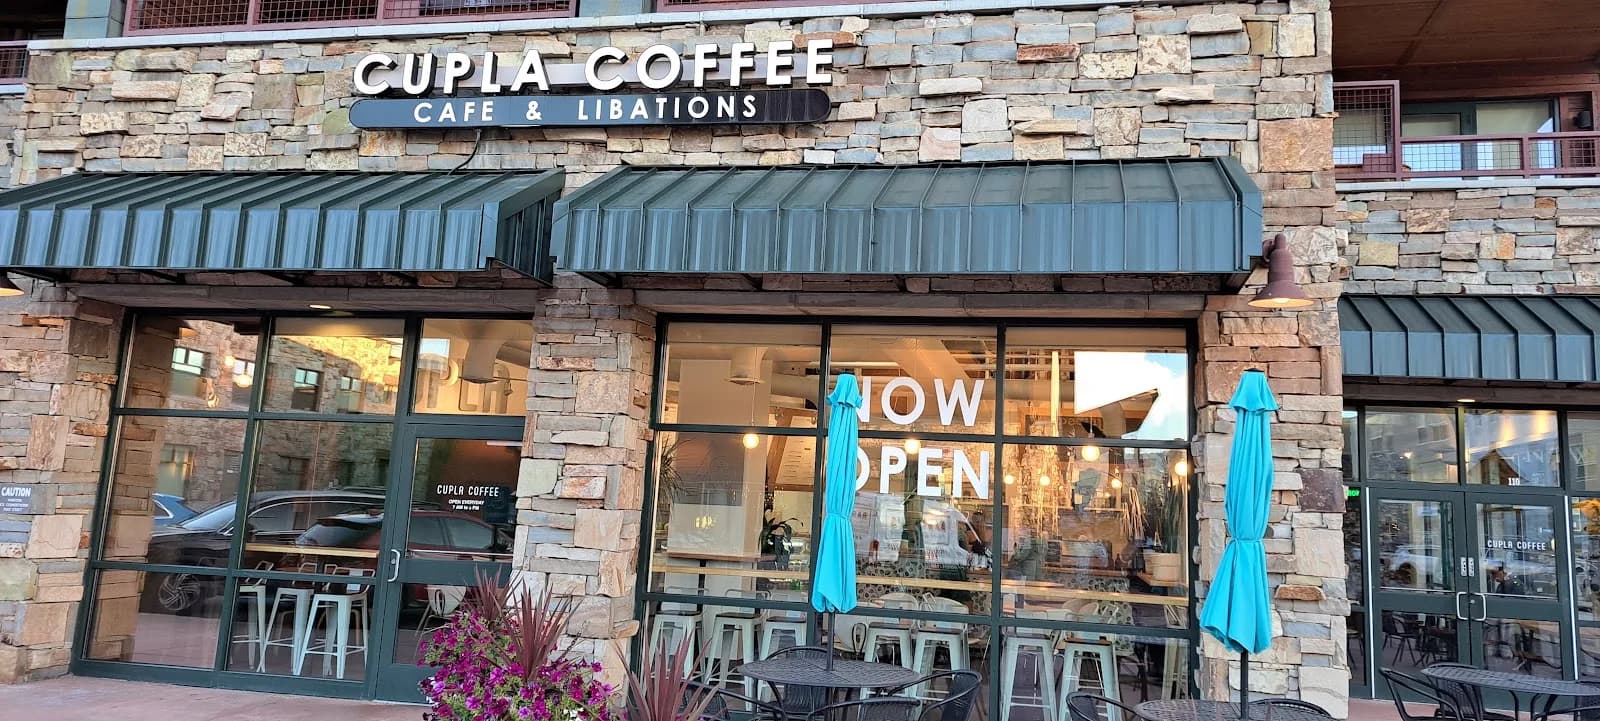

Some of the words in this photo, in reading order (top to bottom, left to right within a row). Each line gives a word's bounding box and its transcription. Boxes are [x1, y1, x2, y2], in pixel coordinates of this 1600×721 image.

[353, 49, 550, 95] CUPLA
[585, 39, 832, 90] COFFEE
[413, 101, 494, 123] CAFE
[526, 100, 542, 121] &
[577, 95, 757, 121] LIBATIONS
[1, 486, 31, 497] CAUTION
[437, 485, 464, 495] CUPLA
[468, 486, 500, 497] COFFEE
[1487, 539, 1513, 549] CUPLA
[1516, 541, 1546, 551] COFFEE
